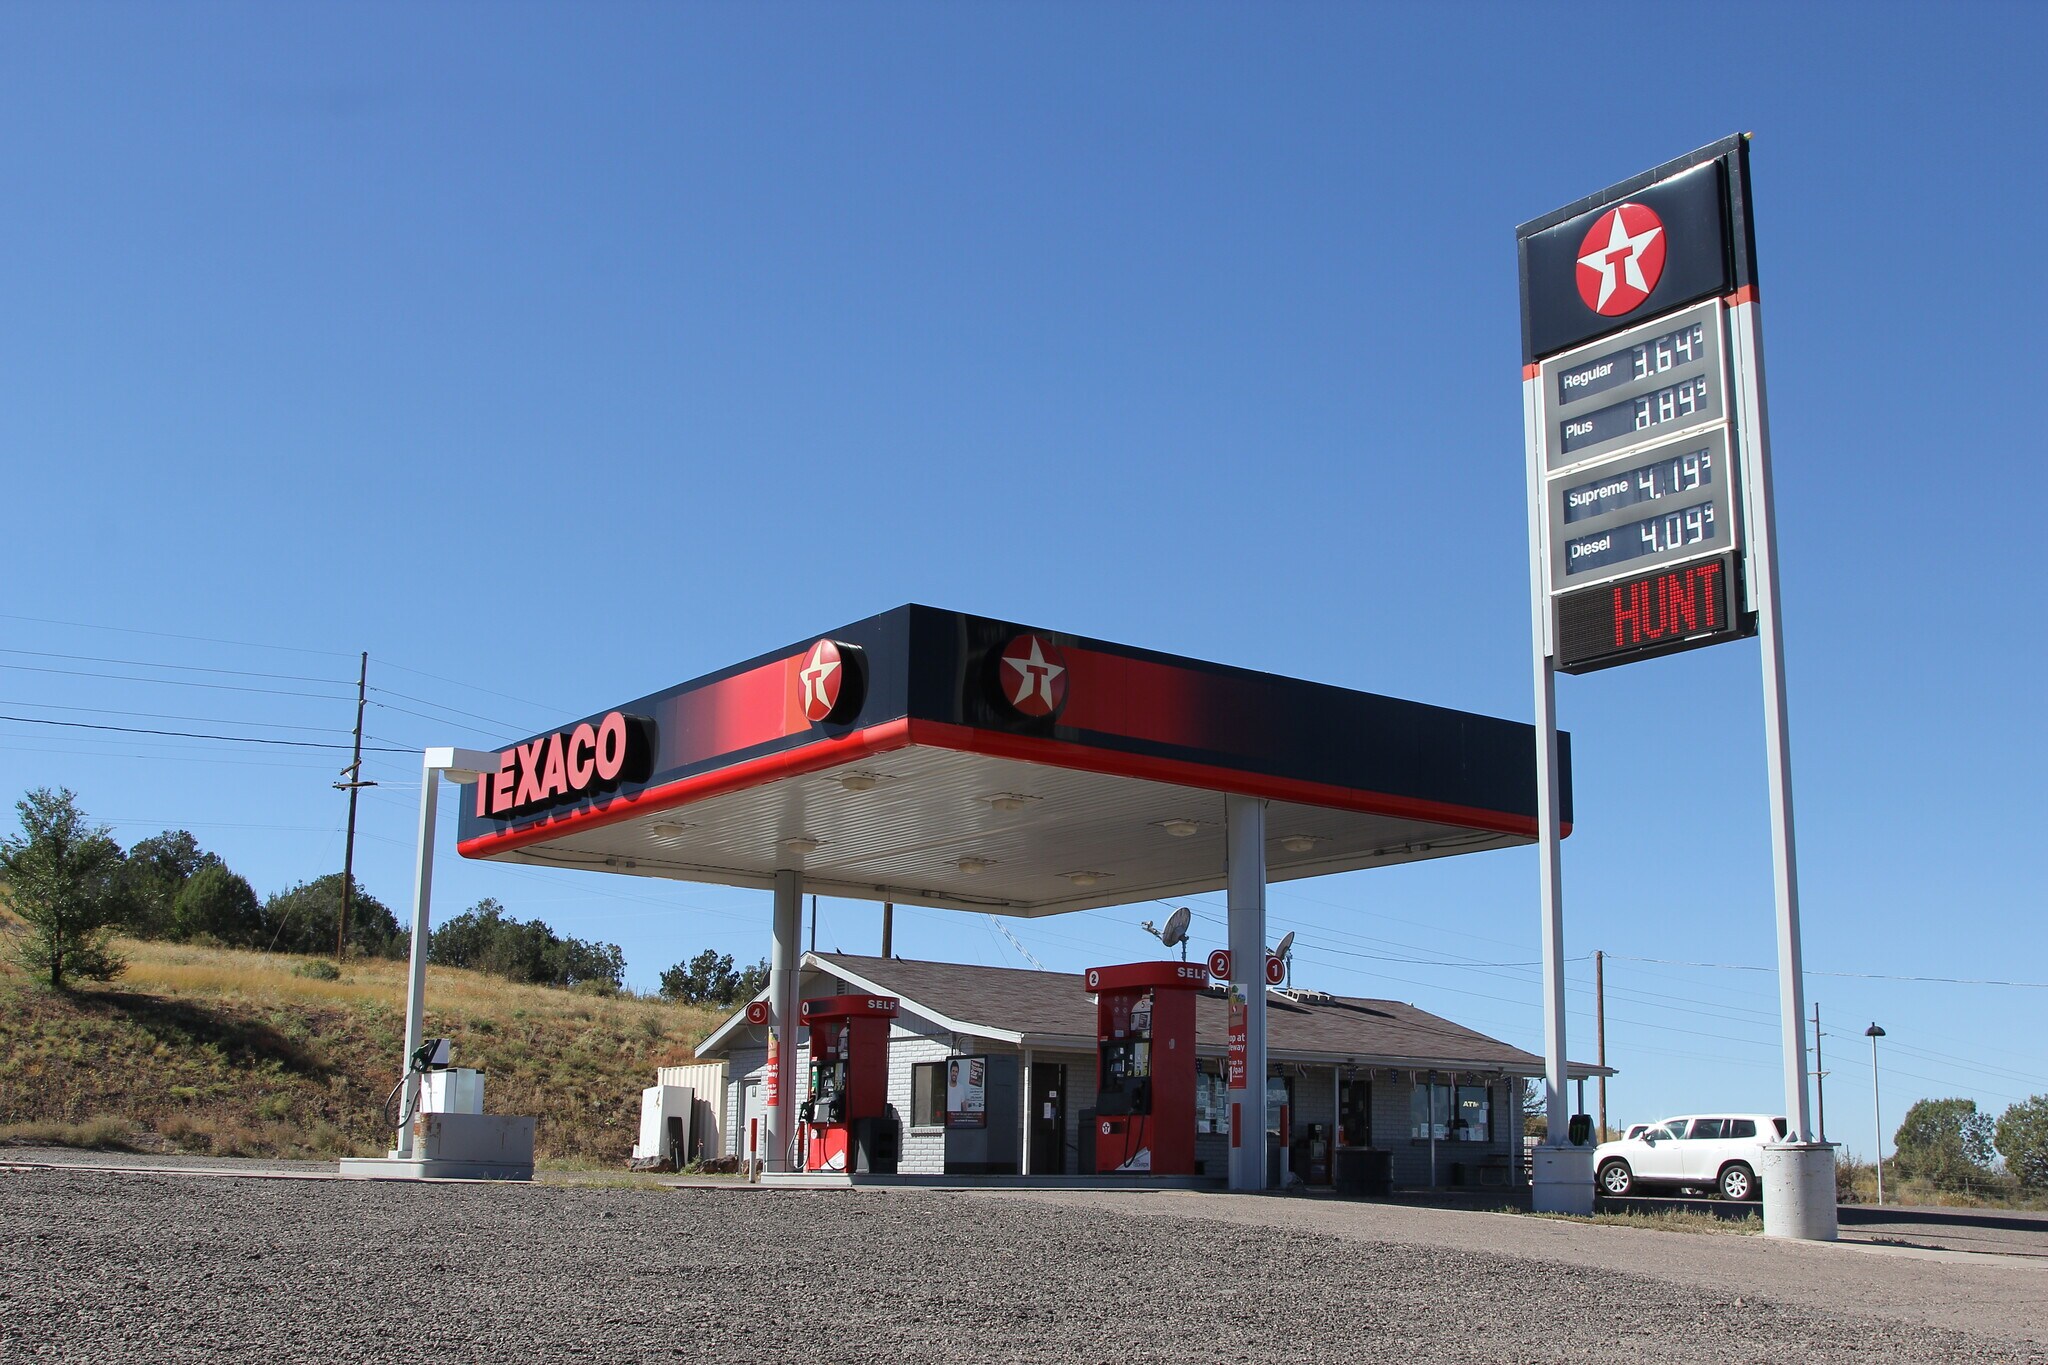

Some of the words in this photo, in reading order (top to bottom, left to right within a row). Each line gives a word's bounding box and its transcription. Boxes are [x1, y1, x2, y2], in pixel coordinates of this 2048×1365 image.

[1564, 363, 1613, 389] Regular
[1566, 421, 1593, 439] Plus
[1569, 480, 1628, 507] Supreme
[1571, 535, 1610, 558] Diesel
[1614, 563, 1720, 646] HUNT
[1217, 958, 1225, 971] 2
[1177, 966, 1207, 979] SELF
[867, 999, 895, 1010] SELF
[753, 1008, 760, 1018] 4
[1237, 1033, 1245, 1042] at
